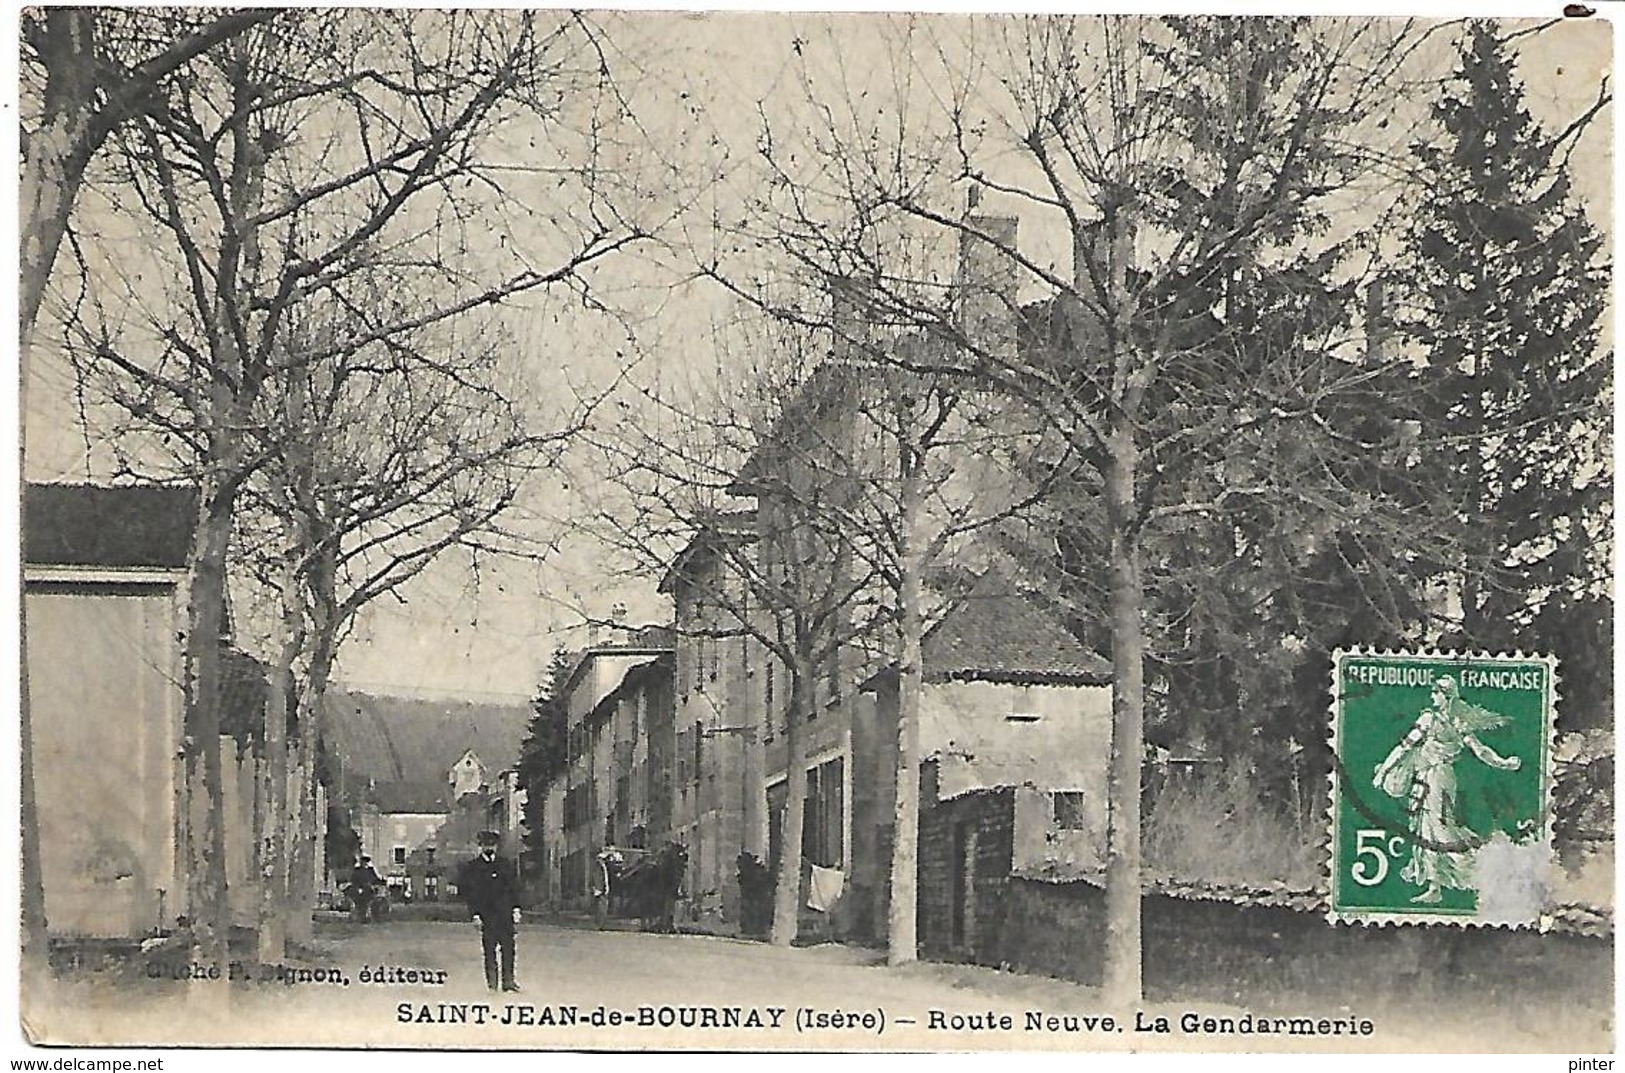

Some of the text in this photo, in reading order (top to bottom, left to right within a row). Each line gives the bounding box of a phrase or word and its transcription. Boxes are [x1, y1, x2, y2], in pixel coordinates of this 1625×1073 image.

[1348, 665, 1541, 691] REPUBLIQUE FRANÇAISE
[358, 965, 448, 985] éditeur
[396, 1003, 786, 1028] SAINT-JEAN-de-BOURNAY
[795, 1007, 886, 1035] (Isère)
[927, 1010, 1013, 1031] Route
[1024, 1011, 1124, 1033] Neuve.
[1134, 1012, 1171, 1034] La
[1180, 1013, 1375, 1036] Gendarmerie
